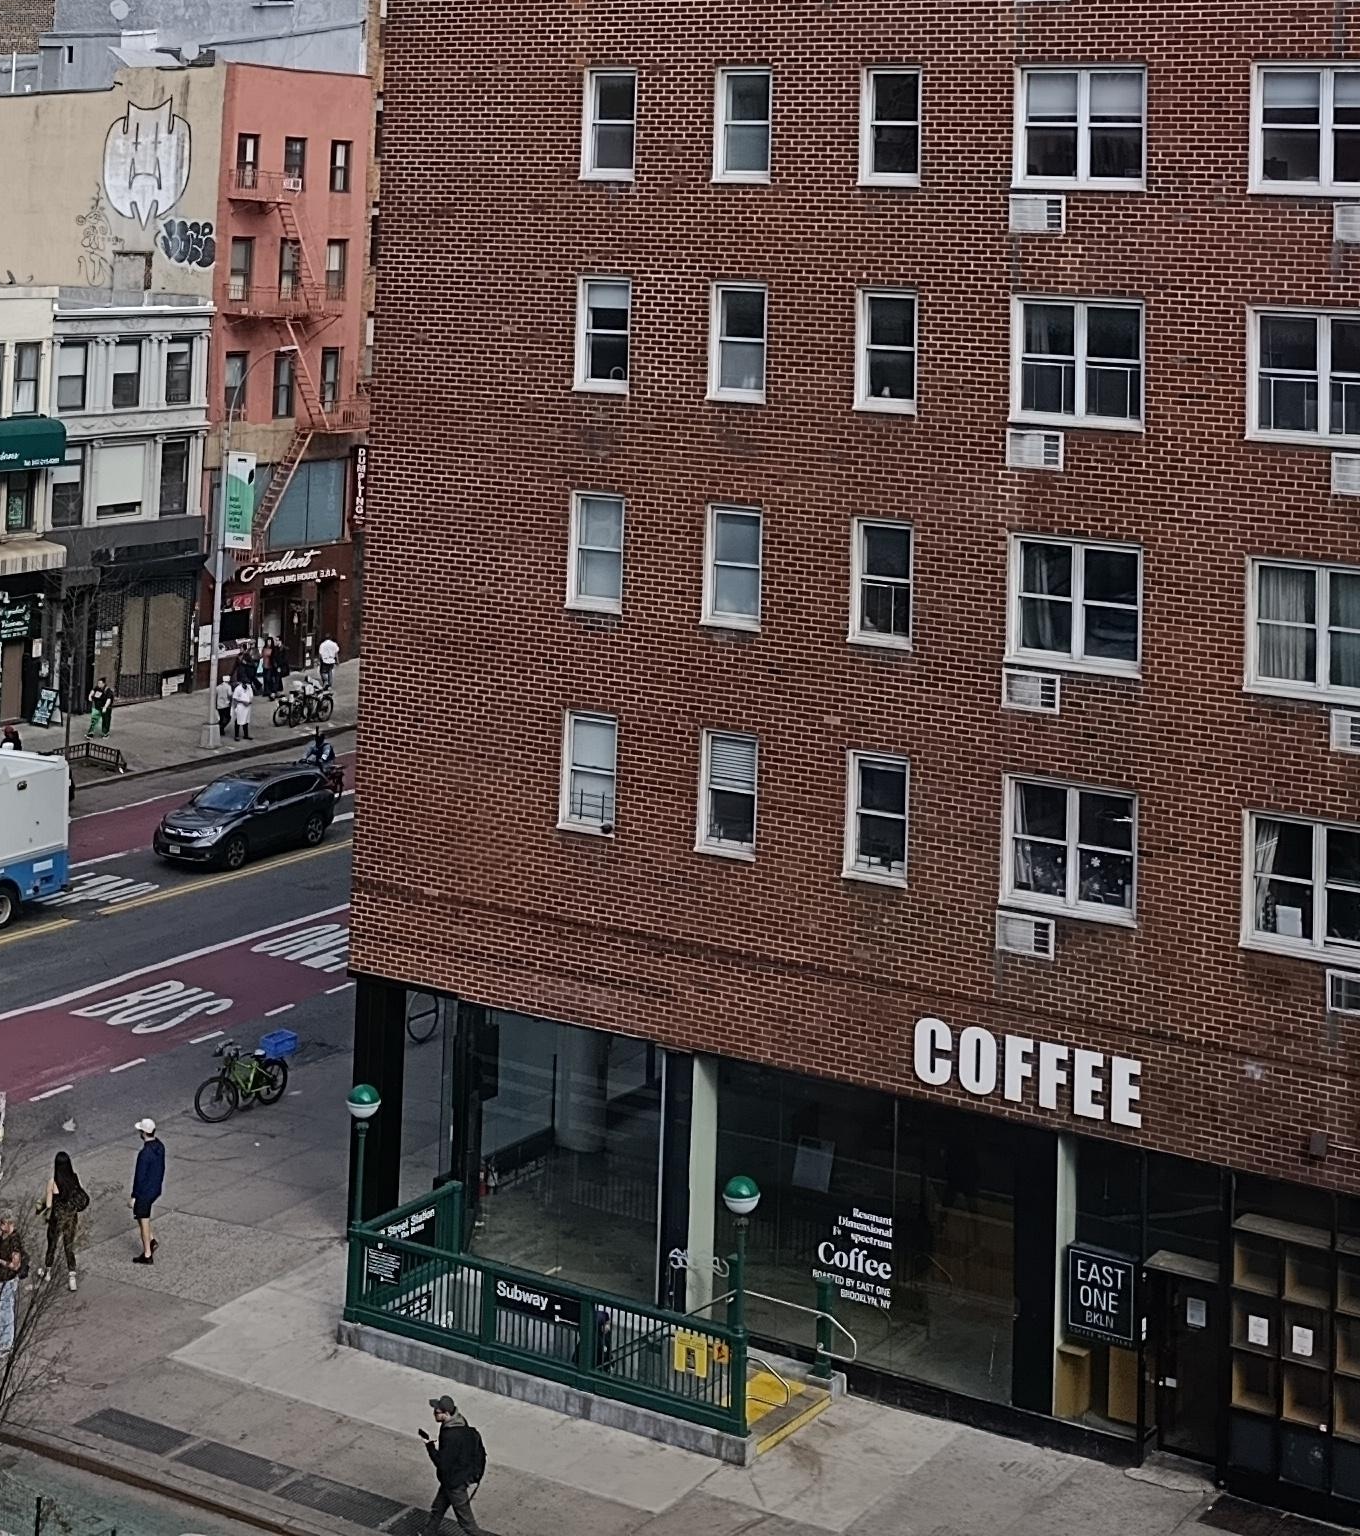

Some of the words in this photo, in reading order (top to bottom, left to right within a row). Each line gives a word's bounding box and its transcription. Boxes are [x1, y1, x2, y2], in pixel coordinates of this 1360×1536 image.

[355, 448, 367, 514] DUMPLING
[240, 549, 322, 583] Excellent
[264, 574, 296, 586] DUMPLING
[250, 923, 351, 973] ONL
[68, 979, 234, 1035] BUS
[913, 1017, 1142, 1129] COFFEE
[387, 1218, 409, 1237] Street
[411, 1209, 435, 1226] Station
[838, 1216, 892, 1238] Dimensional
[853, 1207, 892, 1226] Resonant
[850, 1232, 892, 1250] spectrum
[817, 1241, 892, 1280] Coffee
[1077, 1258, 1126, 1290] EAST
[496, 1279, 549, 1311] Subway
[845, 1277, 855, 1288] BY
[856, 1280, 875, 1293] EAST
[876, 1285, 891, 1297] ONE
[1080, 1284, 1119, 1314] ONE
[880, 1300, 892, 1310] NY
[1085, 1310, 1114, 1329] BKLN
